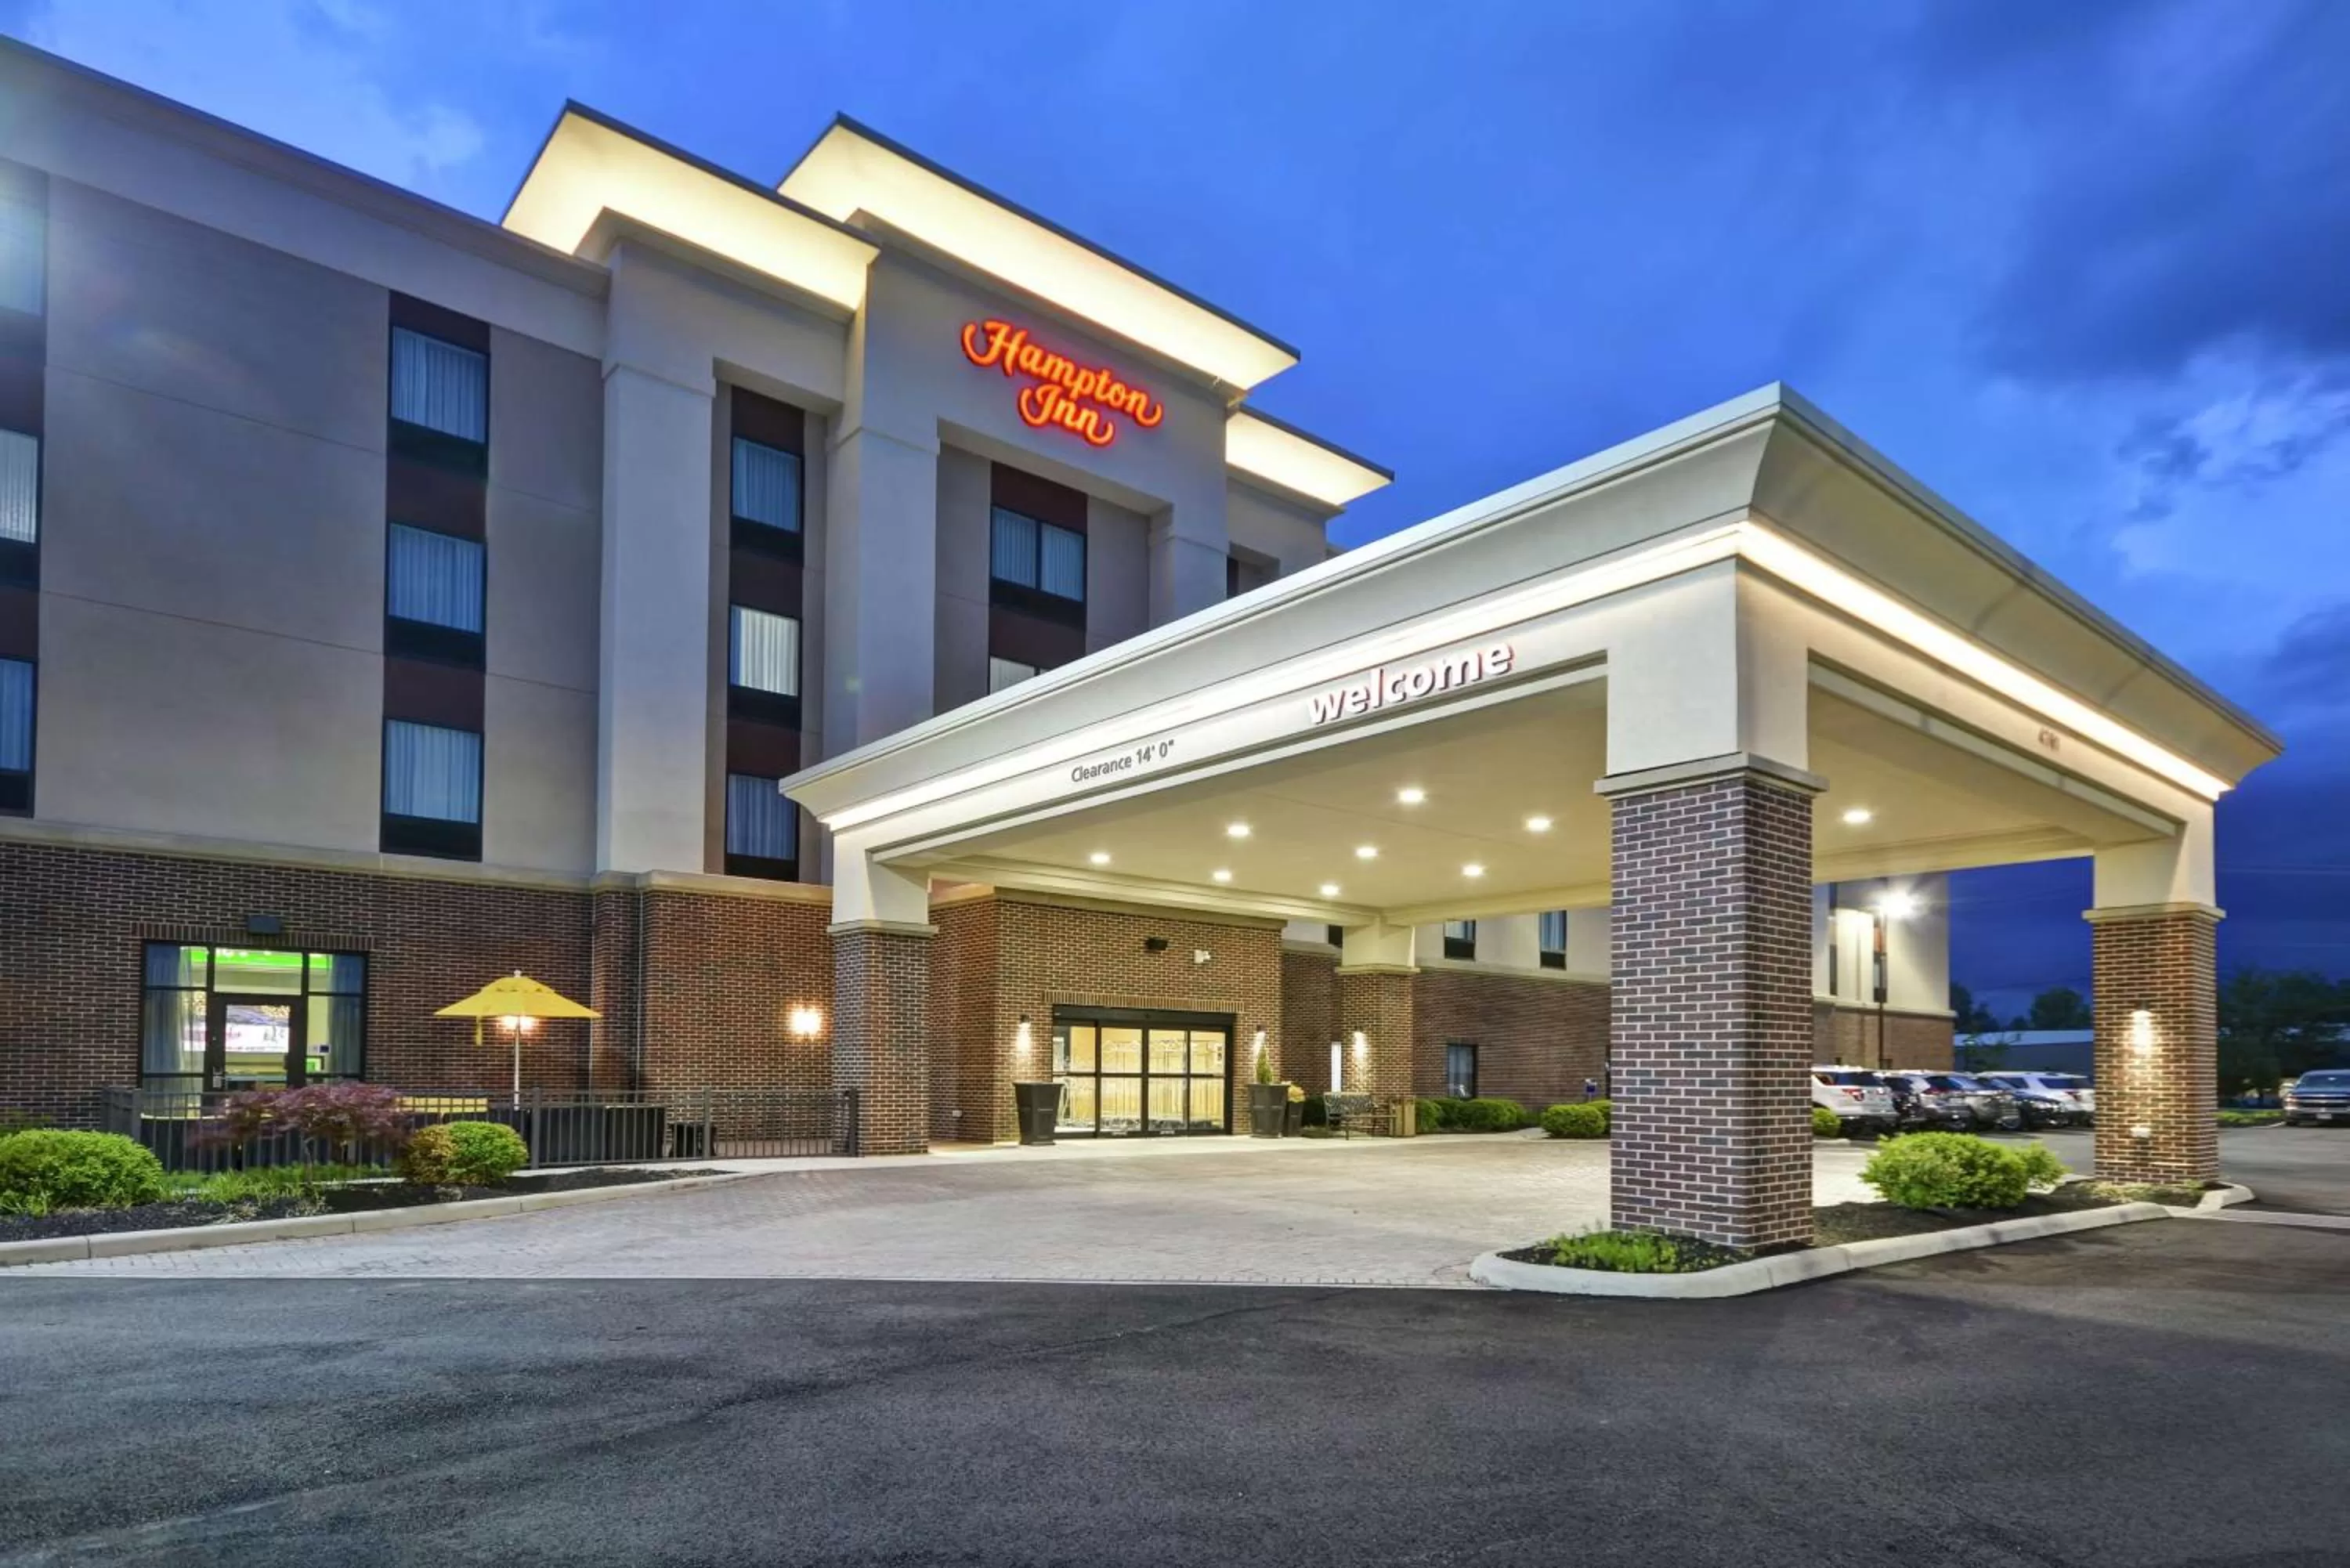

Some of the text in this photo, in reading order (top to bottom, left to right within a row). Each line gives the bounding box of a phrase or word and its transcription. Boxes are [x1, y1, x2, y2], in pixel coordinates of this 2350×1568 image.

[960, 317, 1164, 428] Hampton
[1017, 381, 1115, 447] Inn
[1307, 642, 1515, 724] welcome
[1071, 739, 1174, 782] Clearance 14' 0"
